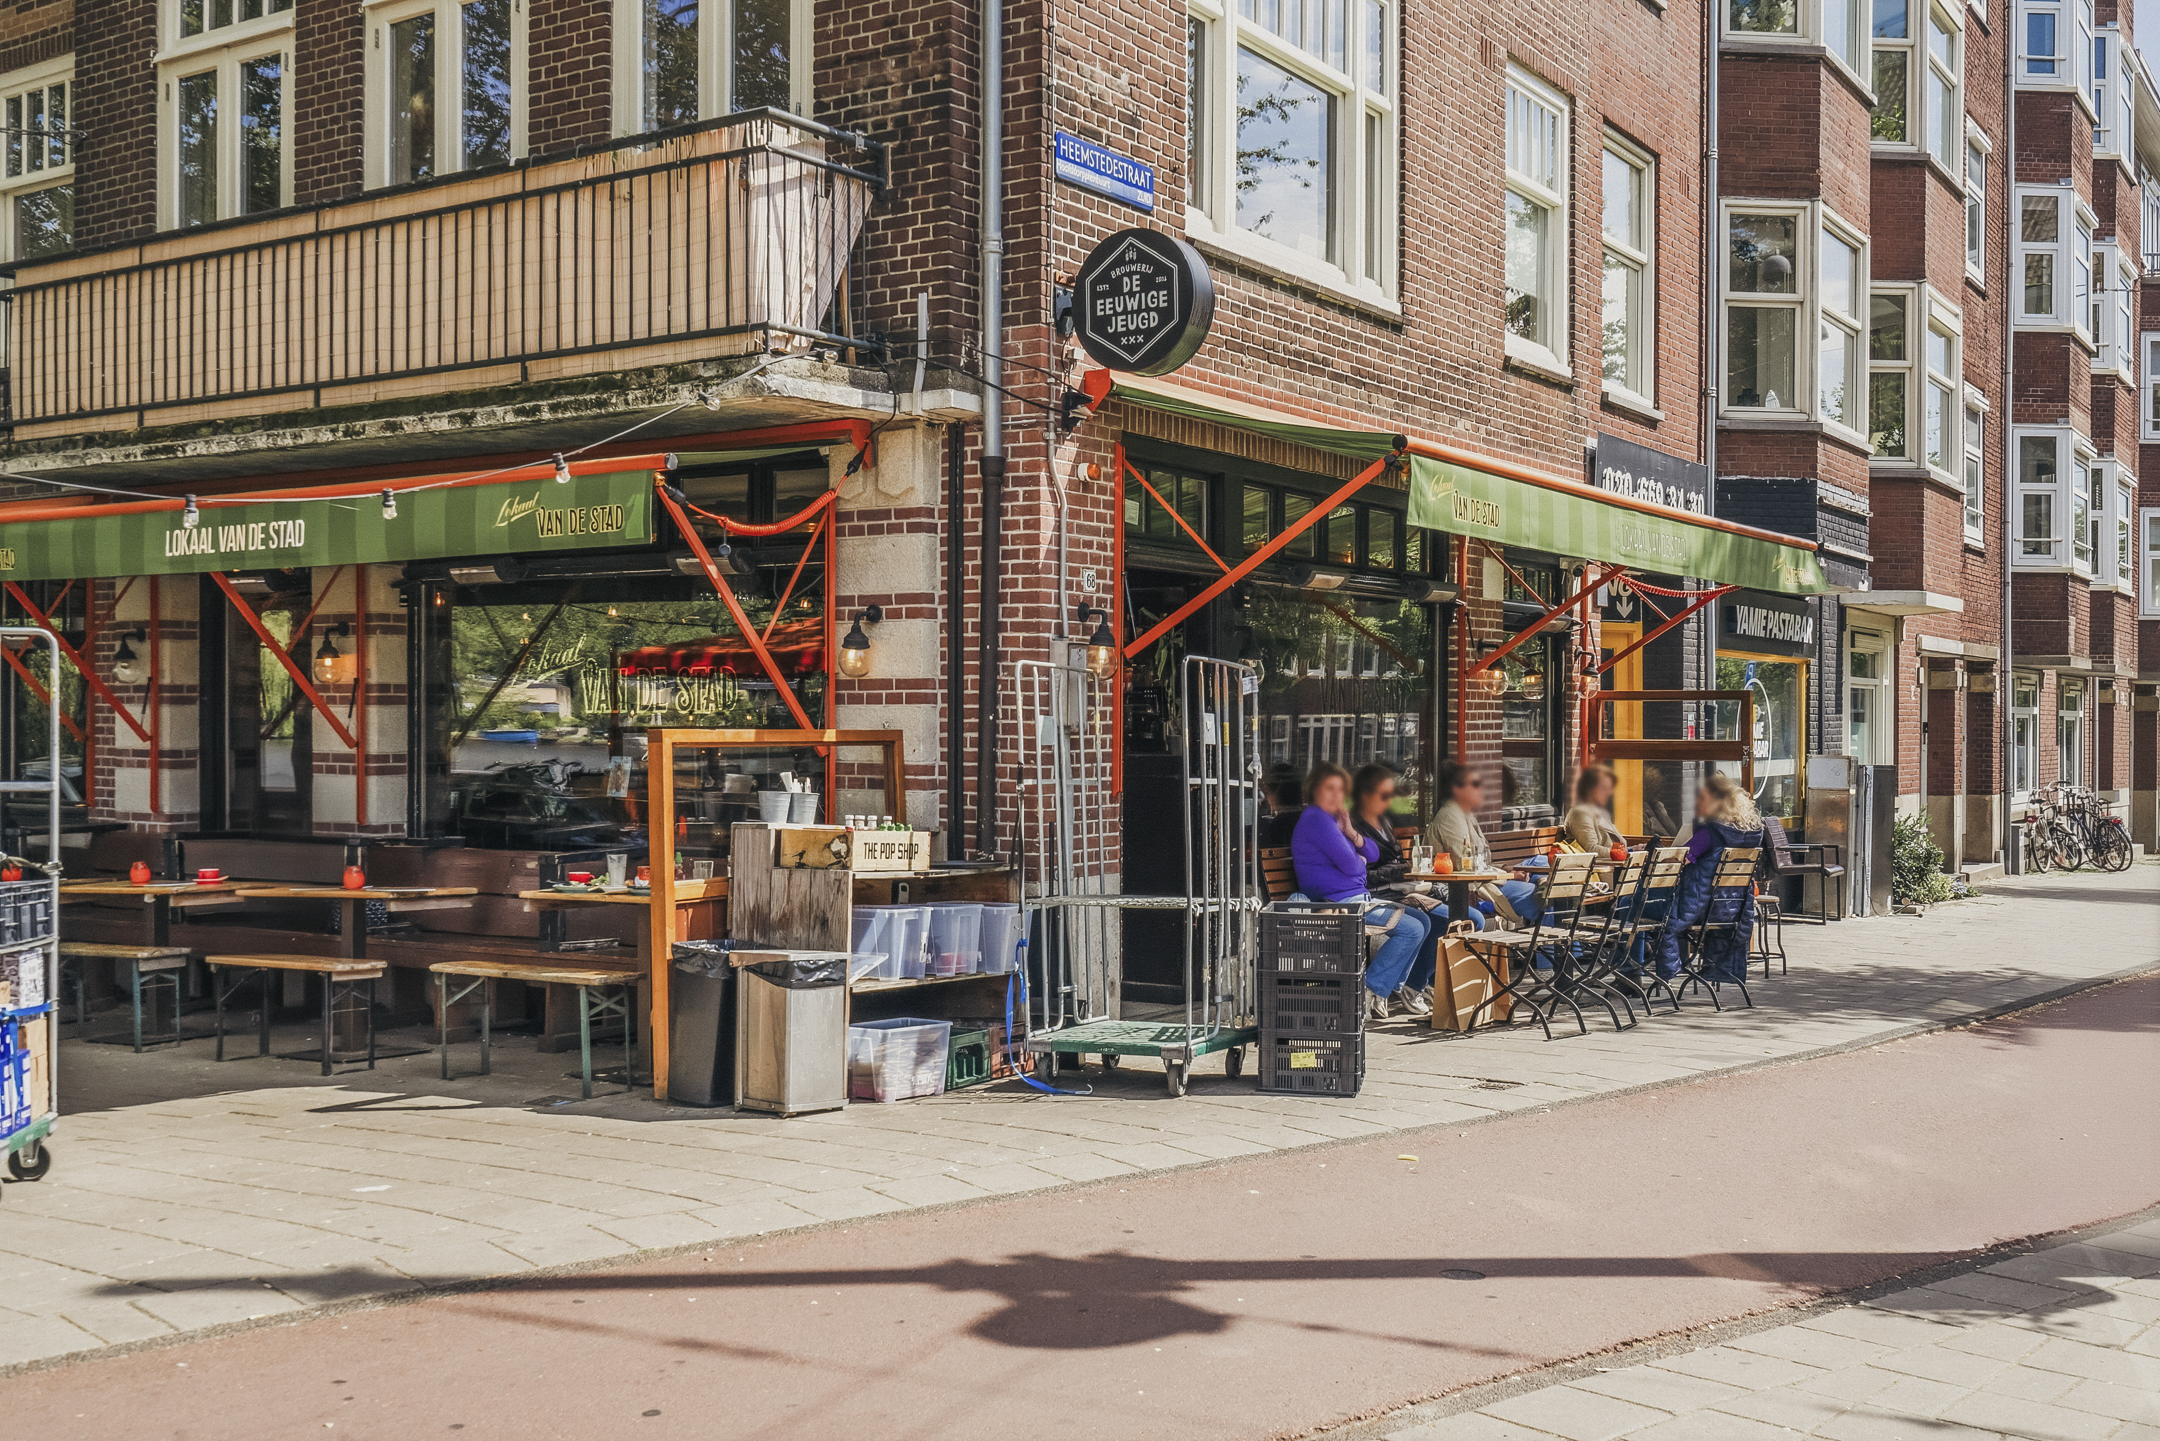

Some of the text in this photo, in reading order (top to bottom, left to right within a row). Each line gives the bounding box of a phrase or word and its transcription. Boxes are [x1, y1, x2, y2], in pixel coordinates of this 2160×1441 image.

[1060, 138, 1151, 190] HEEMSTEDESTRAAT
[1110, 263, 1154, 279] BROUWERIJ
[1122, 274, 1141, 293] DE
[1096, 290, 1168, 316] EEUWIGE
[1107, 311, 1159, 333] JEUGD
[491, 491, 541, 529] Lokaal
[536, 504, 624, 538] VAN DE STAD
[1453, 489, 1500, 528] VAN DE STAD
[165, 519, 305, 557] LOKAAL VAN DE STAD
[0, 548, 16, 570] TAD
[1736, 604, 1813, 644] YAMIE PASTABAR
[580, 657, 738, 715] VAN DE STAD
[863, 842, 919, 860] THE POP SHOP
